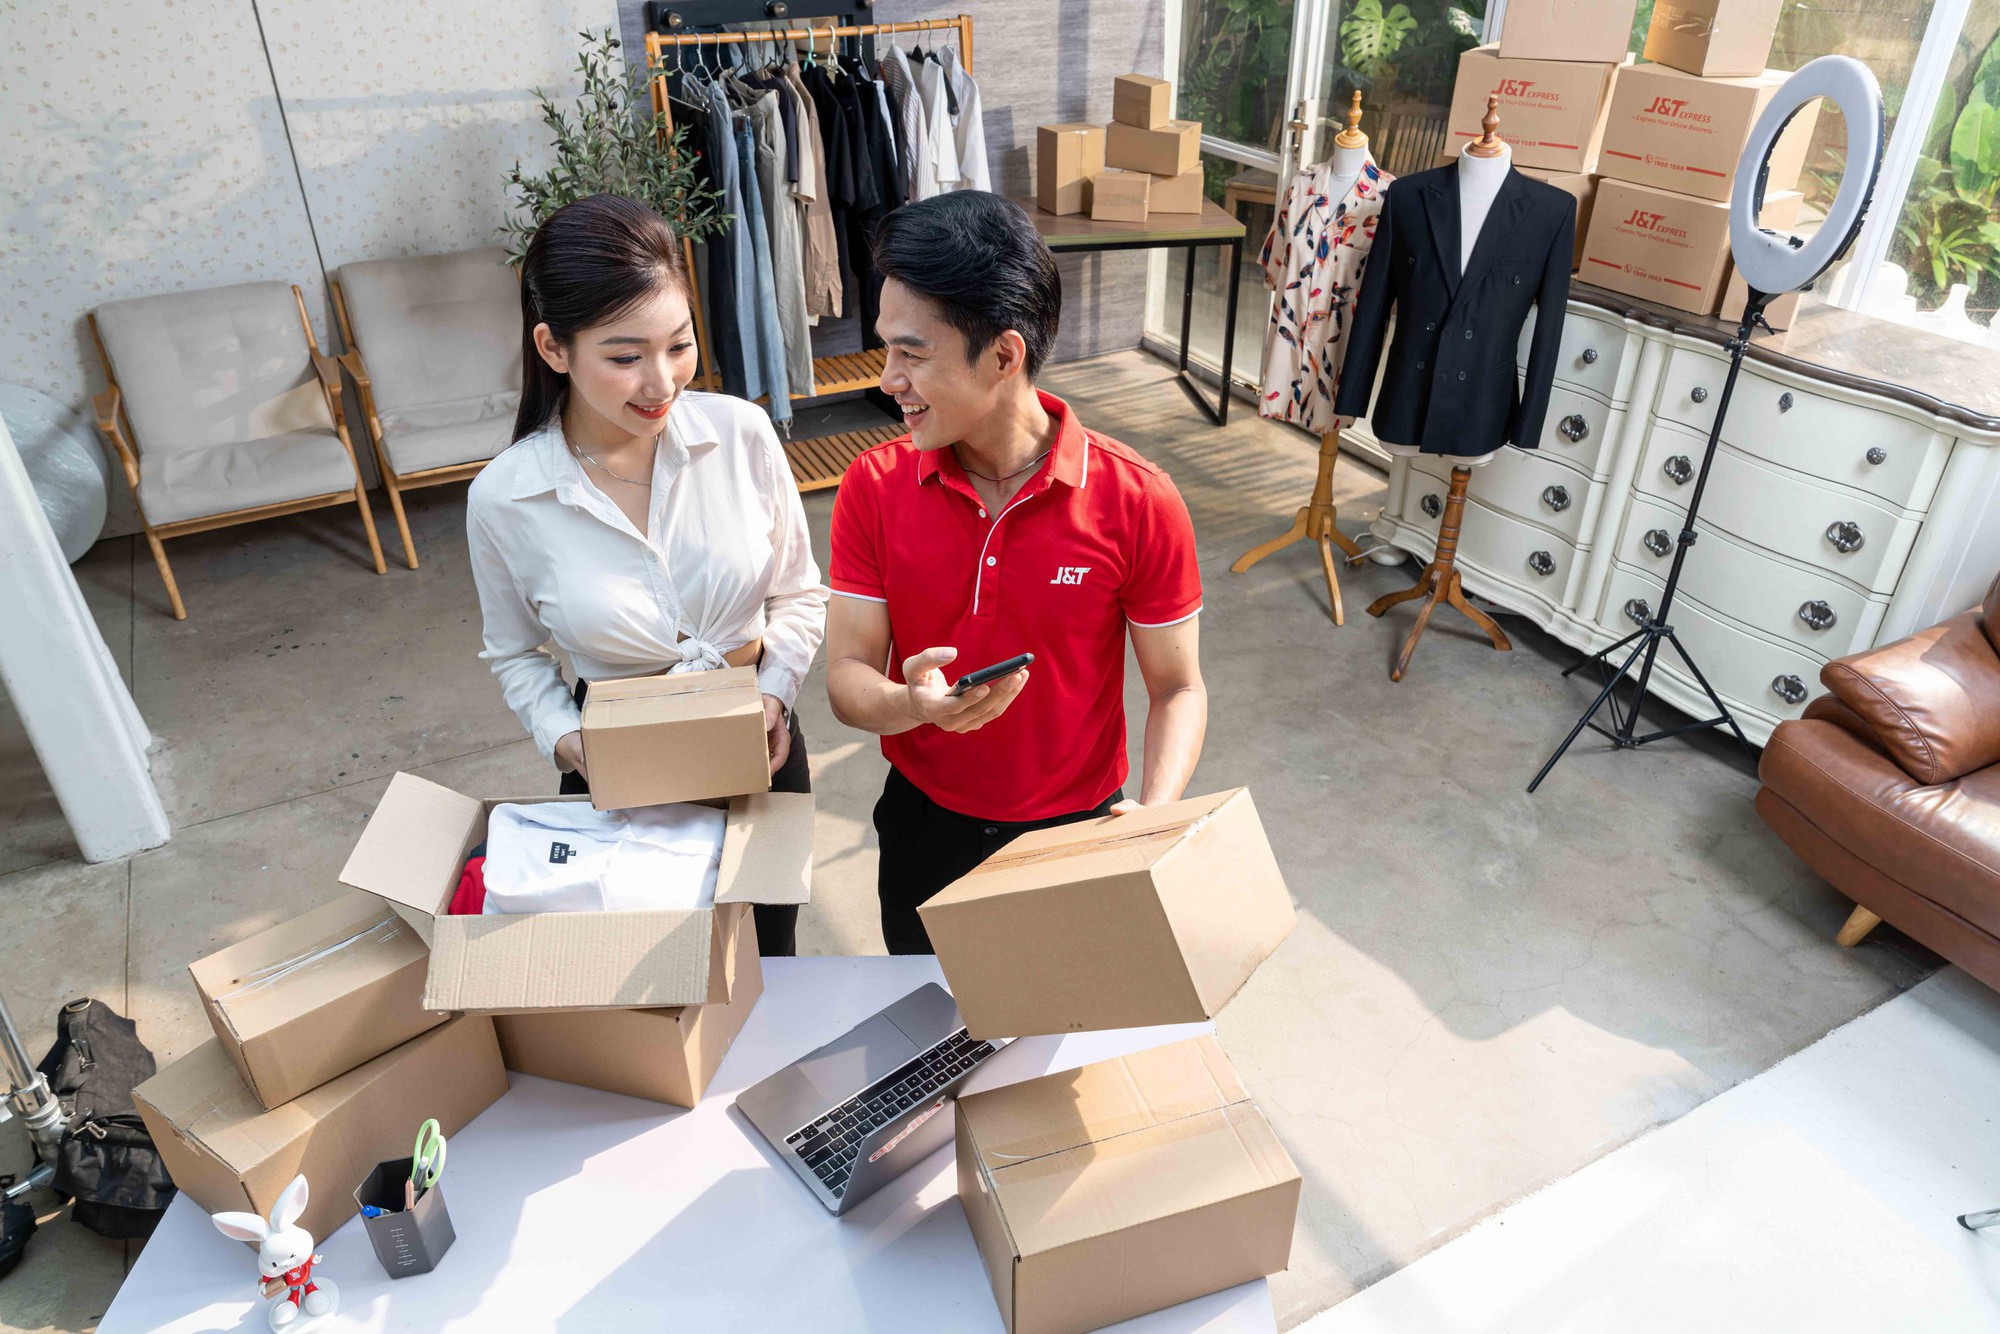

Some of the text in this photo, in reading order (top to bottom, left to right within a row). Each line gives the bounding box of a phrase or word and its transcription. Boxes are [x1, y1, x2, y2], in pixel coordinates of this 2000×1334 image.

[1491, 79, 1560, 101] J&T EXPRESS
[1644, 96, 1712, 123] J&T EXPRESS
[1636, 114, 1713, 134] Express Your Online Business
[1654, 160, 1668, 168] 1900
[1623, 209, 1687, 238] J&T EXPRESS
[1050, 566, 1092, 585] J&T
